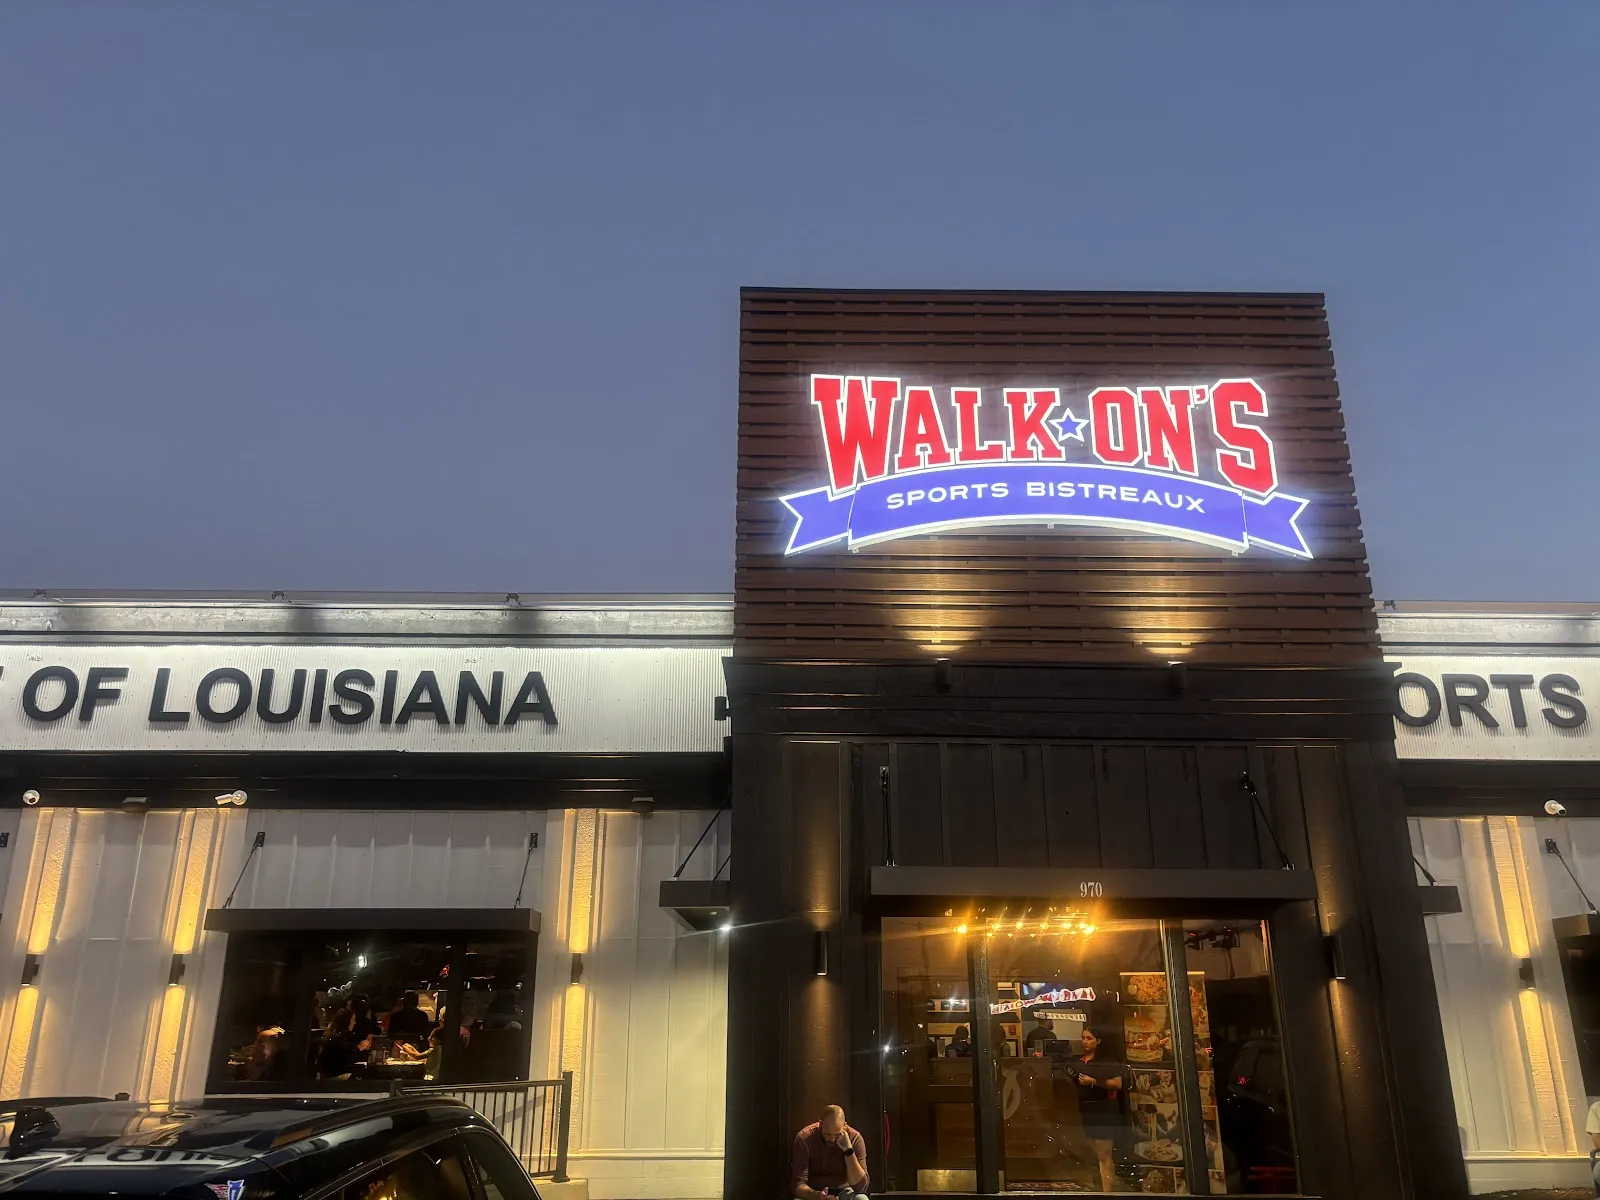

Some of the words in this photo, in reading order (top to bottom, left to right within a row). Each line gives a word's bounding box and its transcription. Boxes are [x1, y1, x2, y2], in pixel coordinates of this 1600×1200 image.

[887, 482, 1009, 509] SPORTS
[1026, 482, 1206, 513] BISTREAUX
[23, 666, 129, 722] OF
[148, 667, 558, 725] LOUISIANA
[1080, 881, 1103, 898] 970
